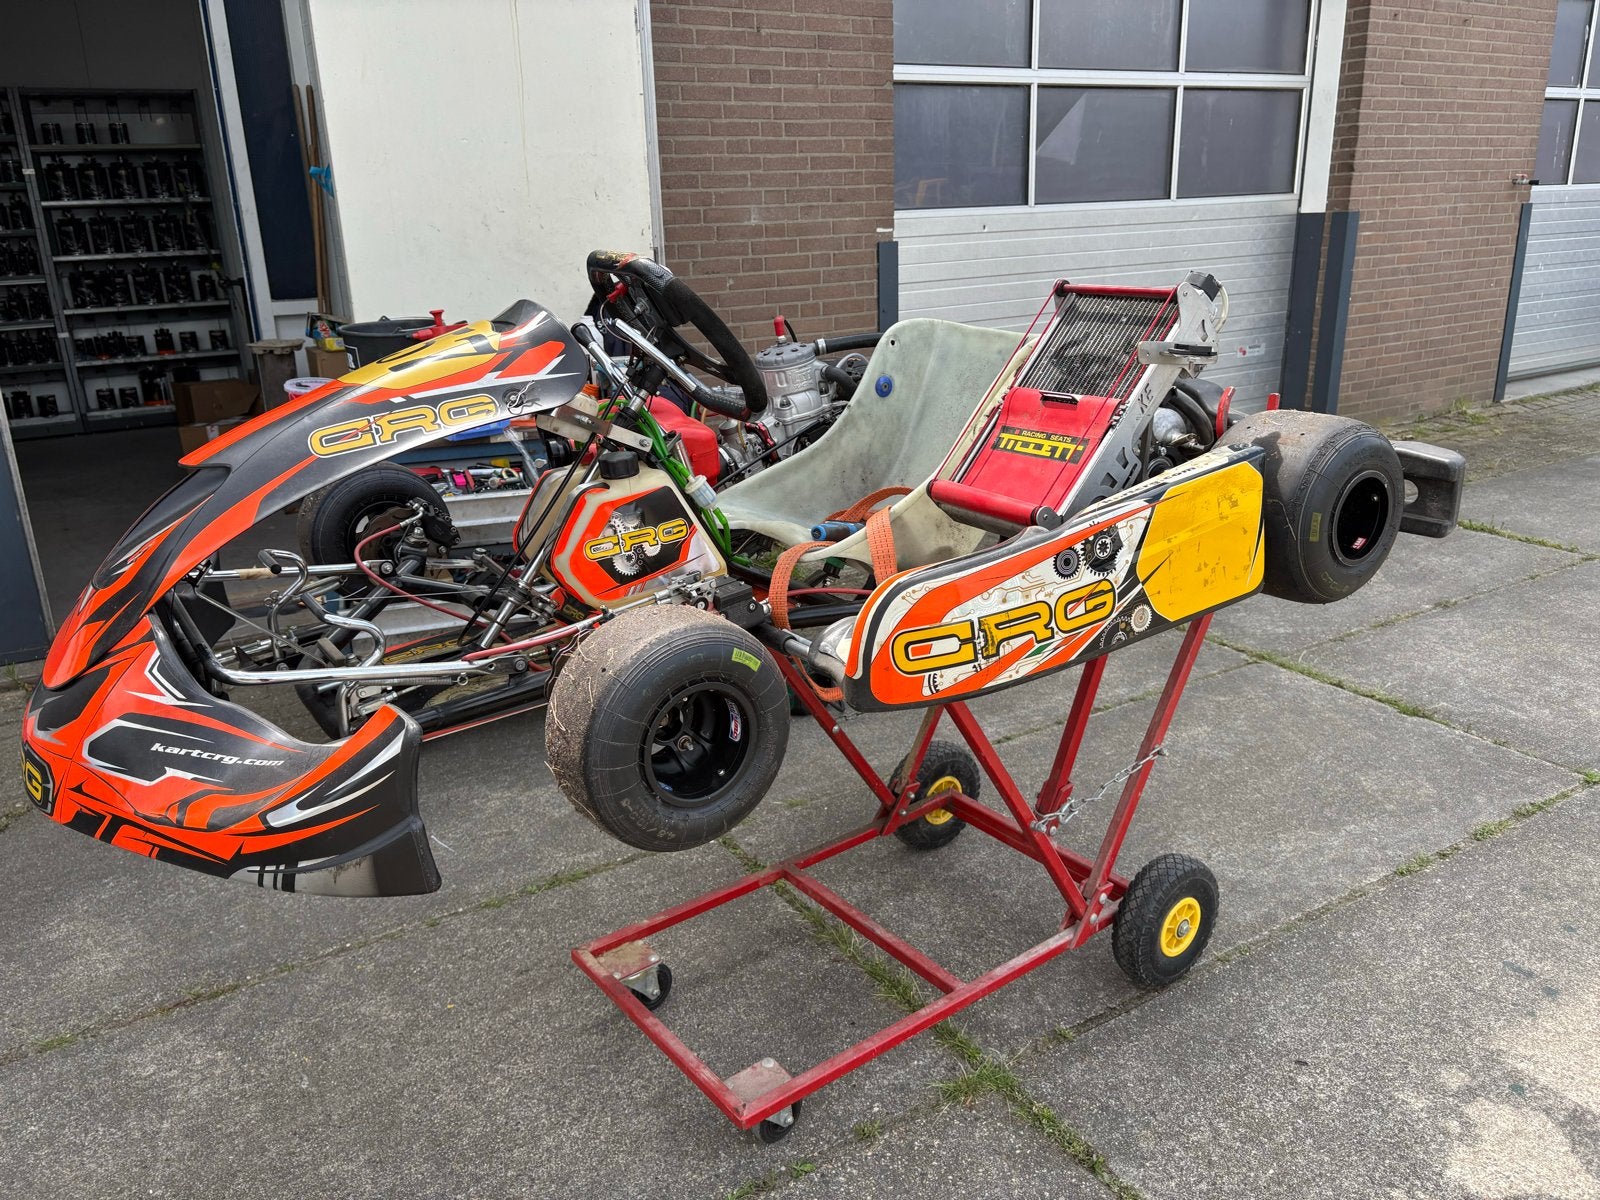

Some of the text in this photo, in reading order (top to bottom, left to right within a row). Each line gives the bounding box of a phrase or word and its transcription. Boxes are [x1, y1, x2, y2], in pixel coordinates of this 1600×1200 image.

[308, 394, 499, 458] CRG
[1021, 430, 1072, 443] RACING SEATS
[999, 432, 1084, 460] TILLETT
[585, 518, 688, 561] CRG
[892, 578, 1117, 675] CRG
[150, 742, 285, 765] kartcrg.com
